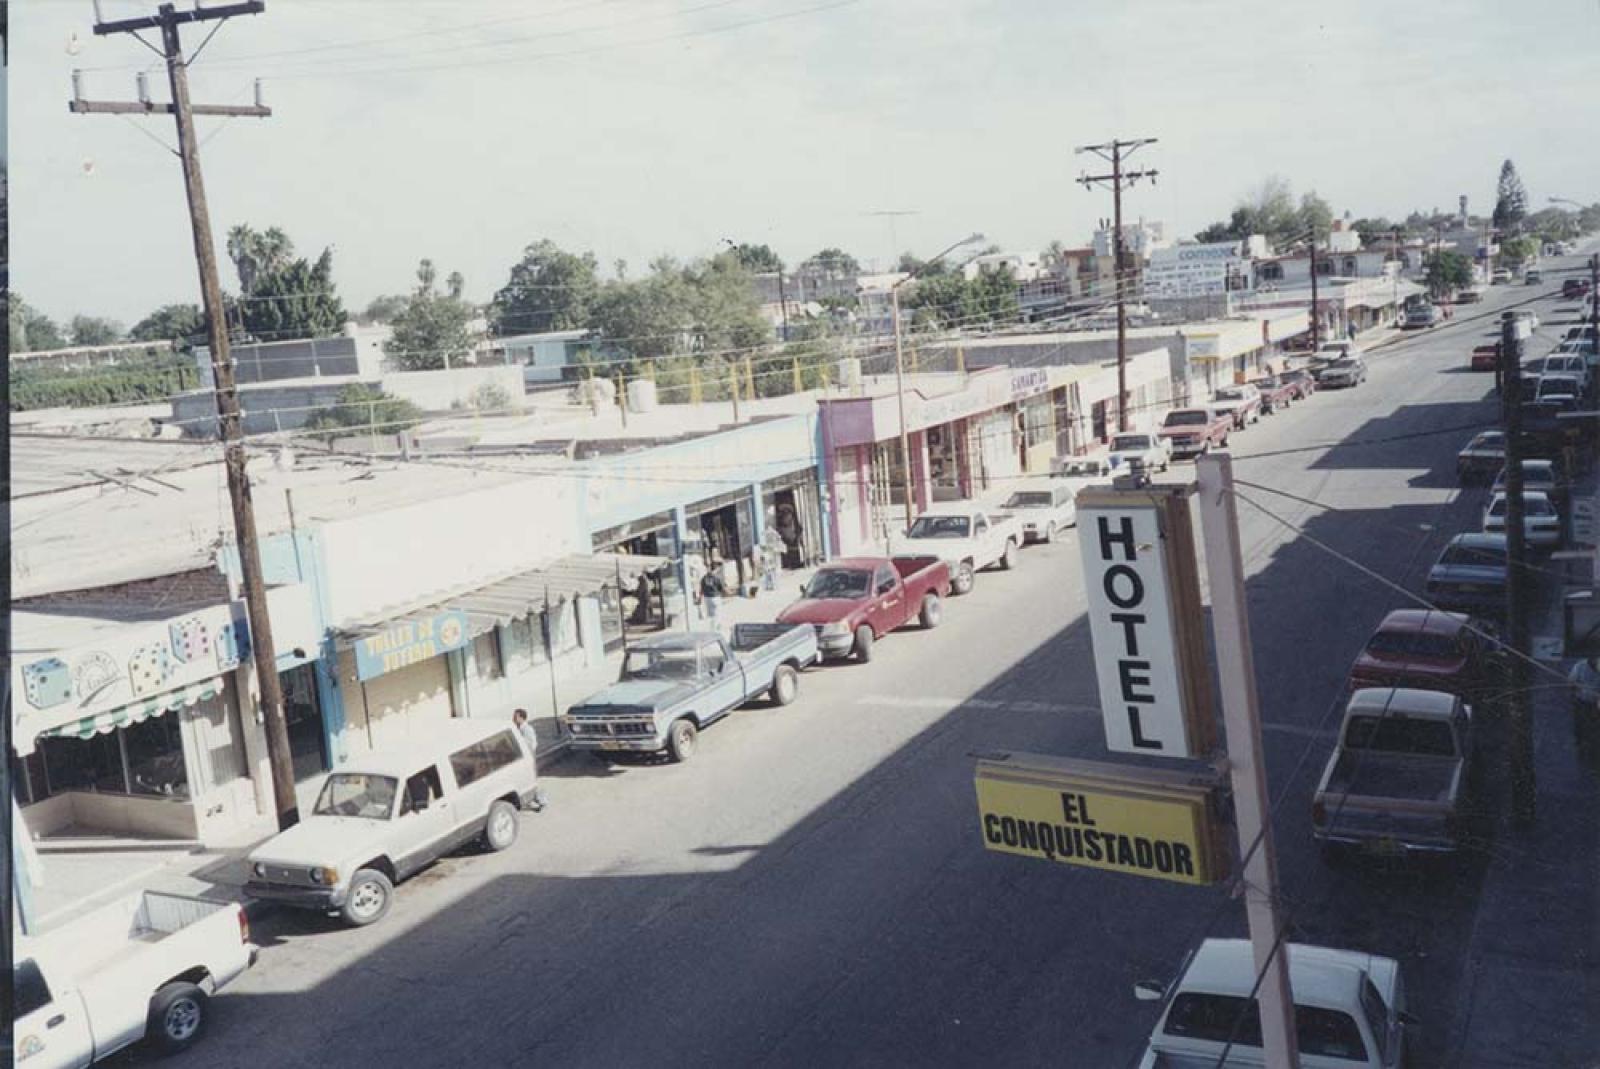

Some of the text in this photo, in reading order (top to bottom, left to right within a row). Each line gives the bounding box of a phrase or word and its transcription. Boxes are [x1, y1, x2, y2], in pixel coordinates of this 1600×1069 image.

[1097, 516, 1163, 750] HOTEL
[1061, 792, 1095, 826] EL
[984, 813, 1193, 876] CONQUISTADOR
